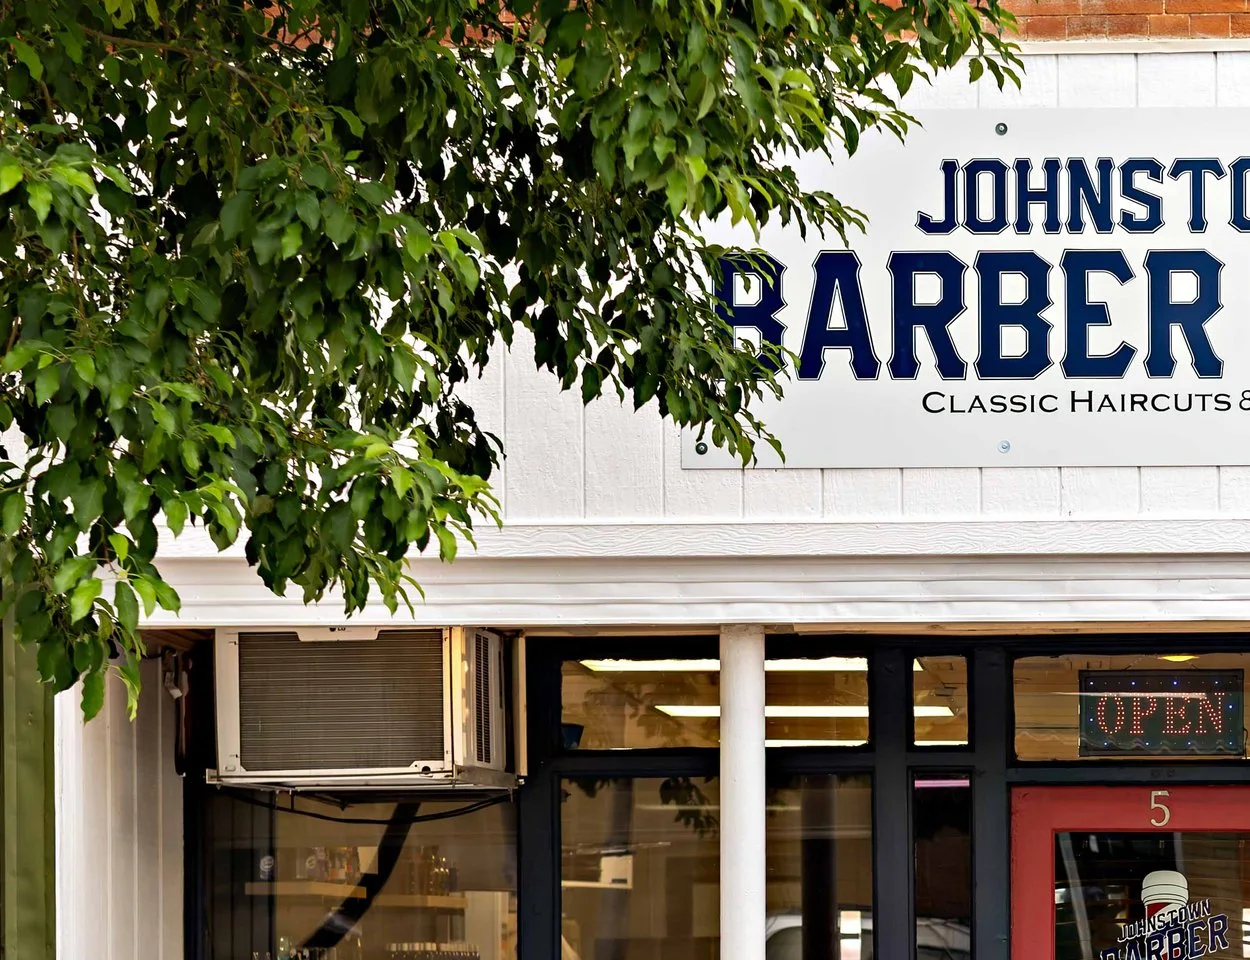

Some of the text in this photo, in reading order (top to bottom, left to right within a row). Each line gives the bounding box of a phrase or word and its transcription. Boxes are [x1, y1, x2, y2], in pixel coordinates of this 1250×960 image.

[711, 249, 1225, 381] BARBER
[921, 390, 1059, 414] CLASSIC
[1069, 390, 1232, 413] HAIRCUTS
[1097, 691, 1225, 735] OPEN
[1150, 790, 1171, 827] 5
[1117, 898, 1211, 943] JOHNSTOWN
